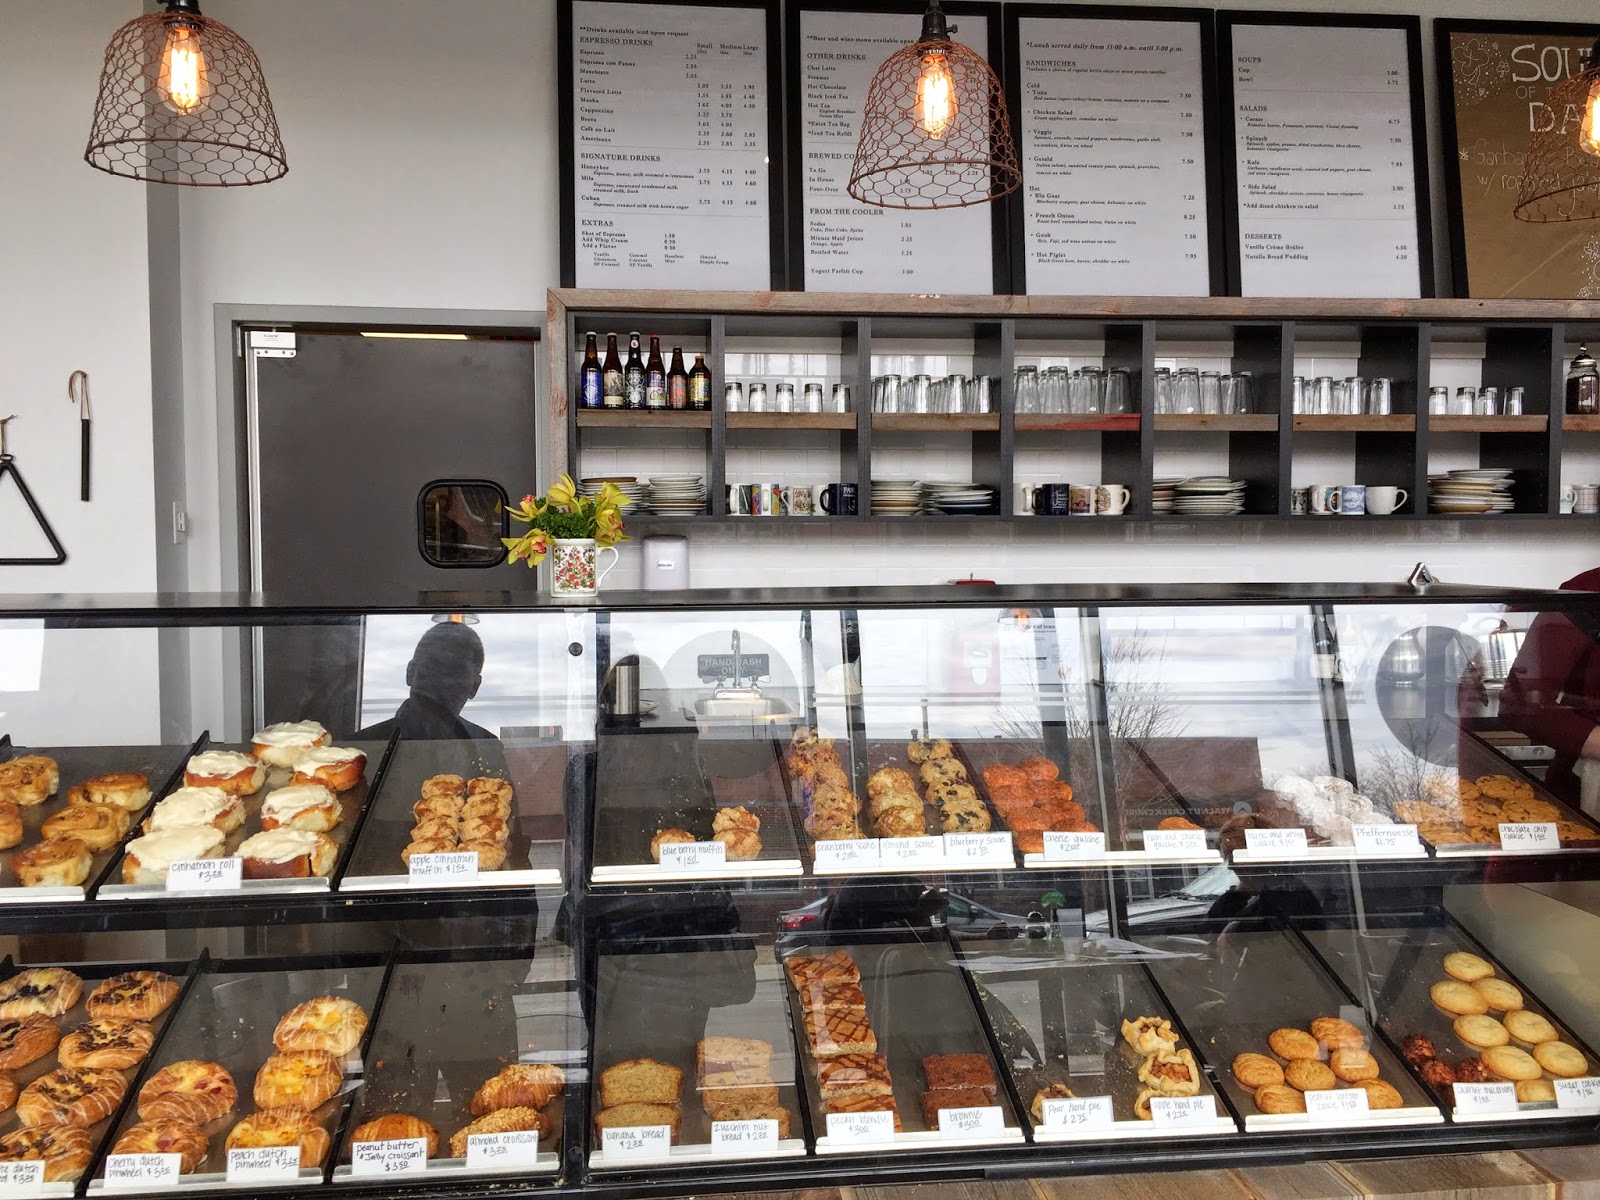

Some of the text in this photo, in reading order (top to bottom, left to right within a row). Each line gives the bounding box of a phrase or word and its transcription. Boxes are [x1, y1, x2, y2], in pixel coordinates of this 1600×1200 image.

[580, 37, 653, 46] ESPRESSO DRINKS
[1516, 86, 1536, 99] OF
[581, 153, 660, 162] SIGNATURE DRINKS
[705, 658, 730, 666] HAND
[1356, 826, 1416, 837] Pfeffernuesse
[1534, 825, 1548, 833] chip
[816, 842, 876, 851] cranberry scone
[882, 842, 936, 851] almond scone
[950, 838, 986, 850] blueberry
[1375, 838, 1395, 846] $1.75
[698, 844, 723, 854] muffin
[172, 859, 234, 872] cinnamon roll
[410, 855, 474, 867] apple cinnamon
[412, 866, 443, 875] muffin
[1557, 1081, 1578, 1092] sugar
[1308, 1092, 1359, 1101] peanut butter
[1068, 1101, 1086, 1112] hand
[1088, 1102, 1102, 1115] pie
[1152, 1099, 1204, 1110] apple hand pie
[949, 1109, 982, 1122] brownie
[714, 1122, 769, 1132] zucchini nut
[830, 1117, 855, 1128] pecan
[469, 1134, 538, 1146] almond croissant
[606, 1129, 665, 1140] banana bread
[721, 1131, 742, 1141] bread
[356, 1141, 419, 1157] peanut butter
[388, 1149, 425, 1160] croissant
[140, 1155, 164, 1166] dutch
[231, 1149, 287, 1163] peach dutch
[13, 1164, 39, 1173] dutch
[235, 1159, 271, 1171] pinwheel
[109, 1168, 142, 1178] pinwheel
